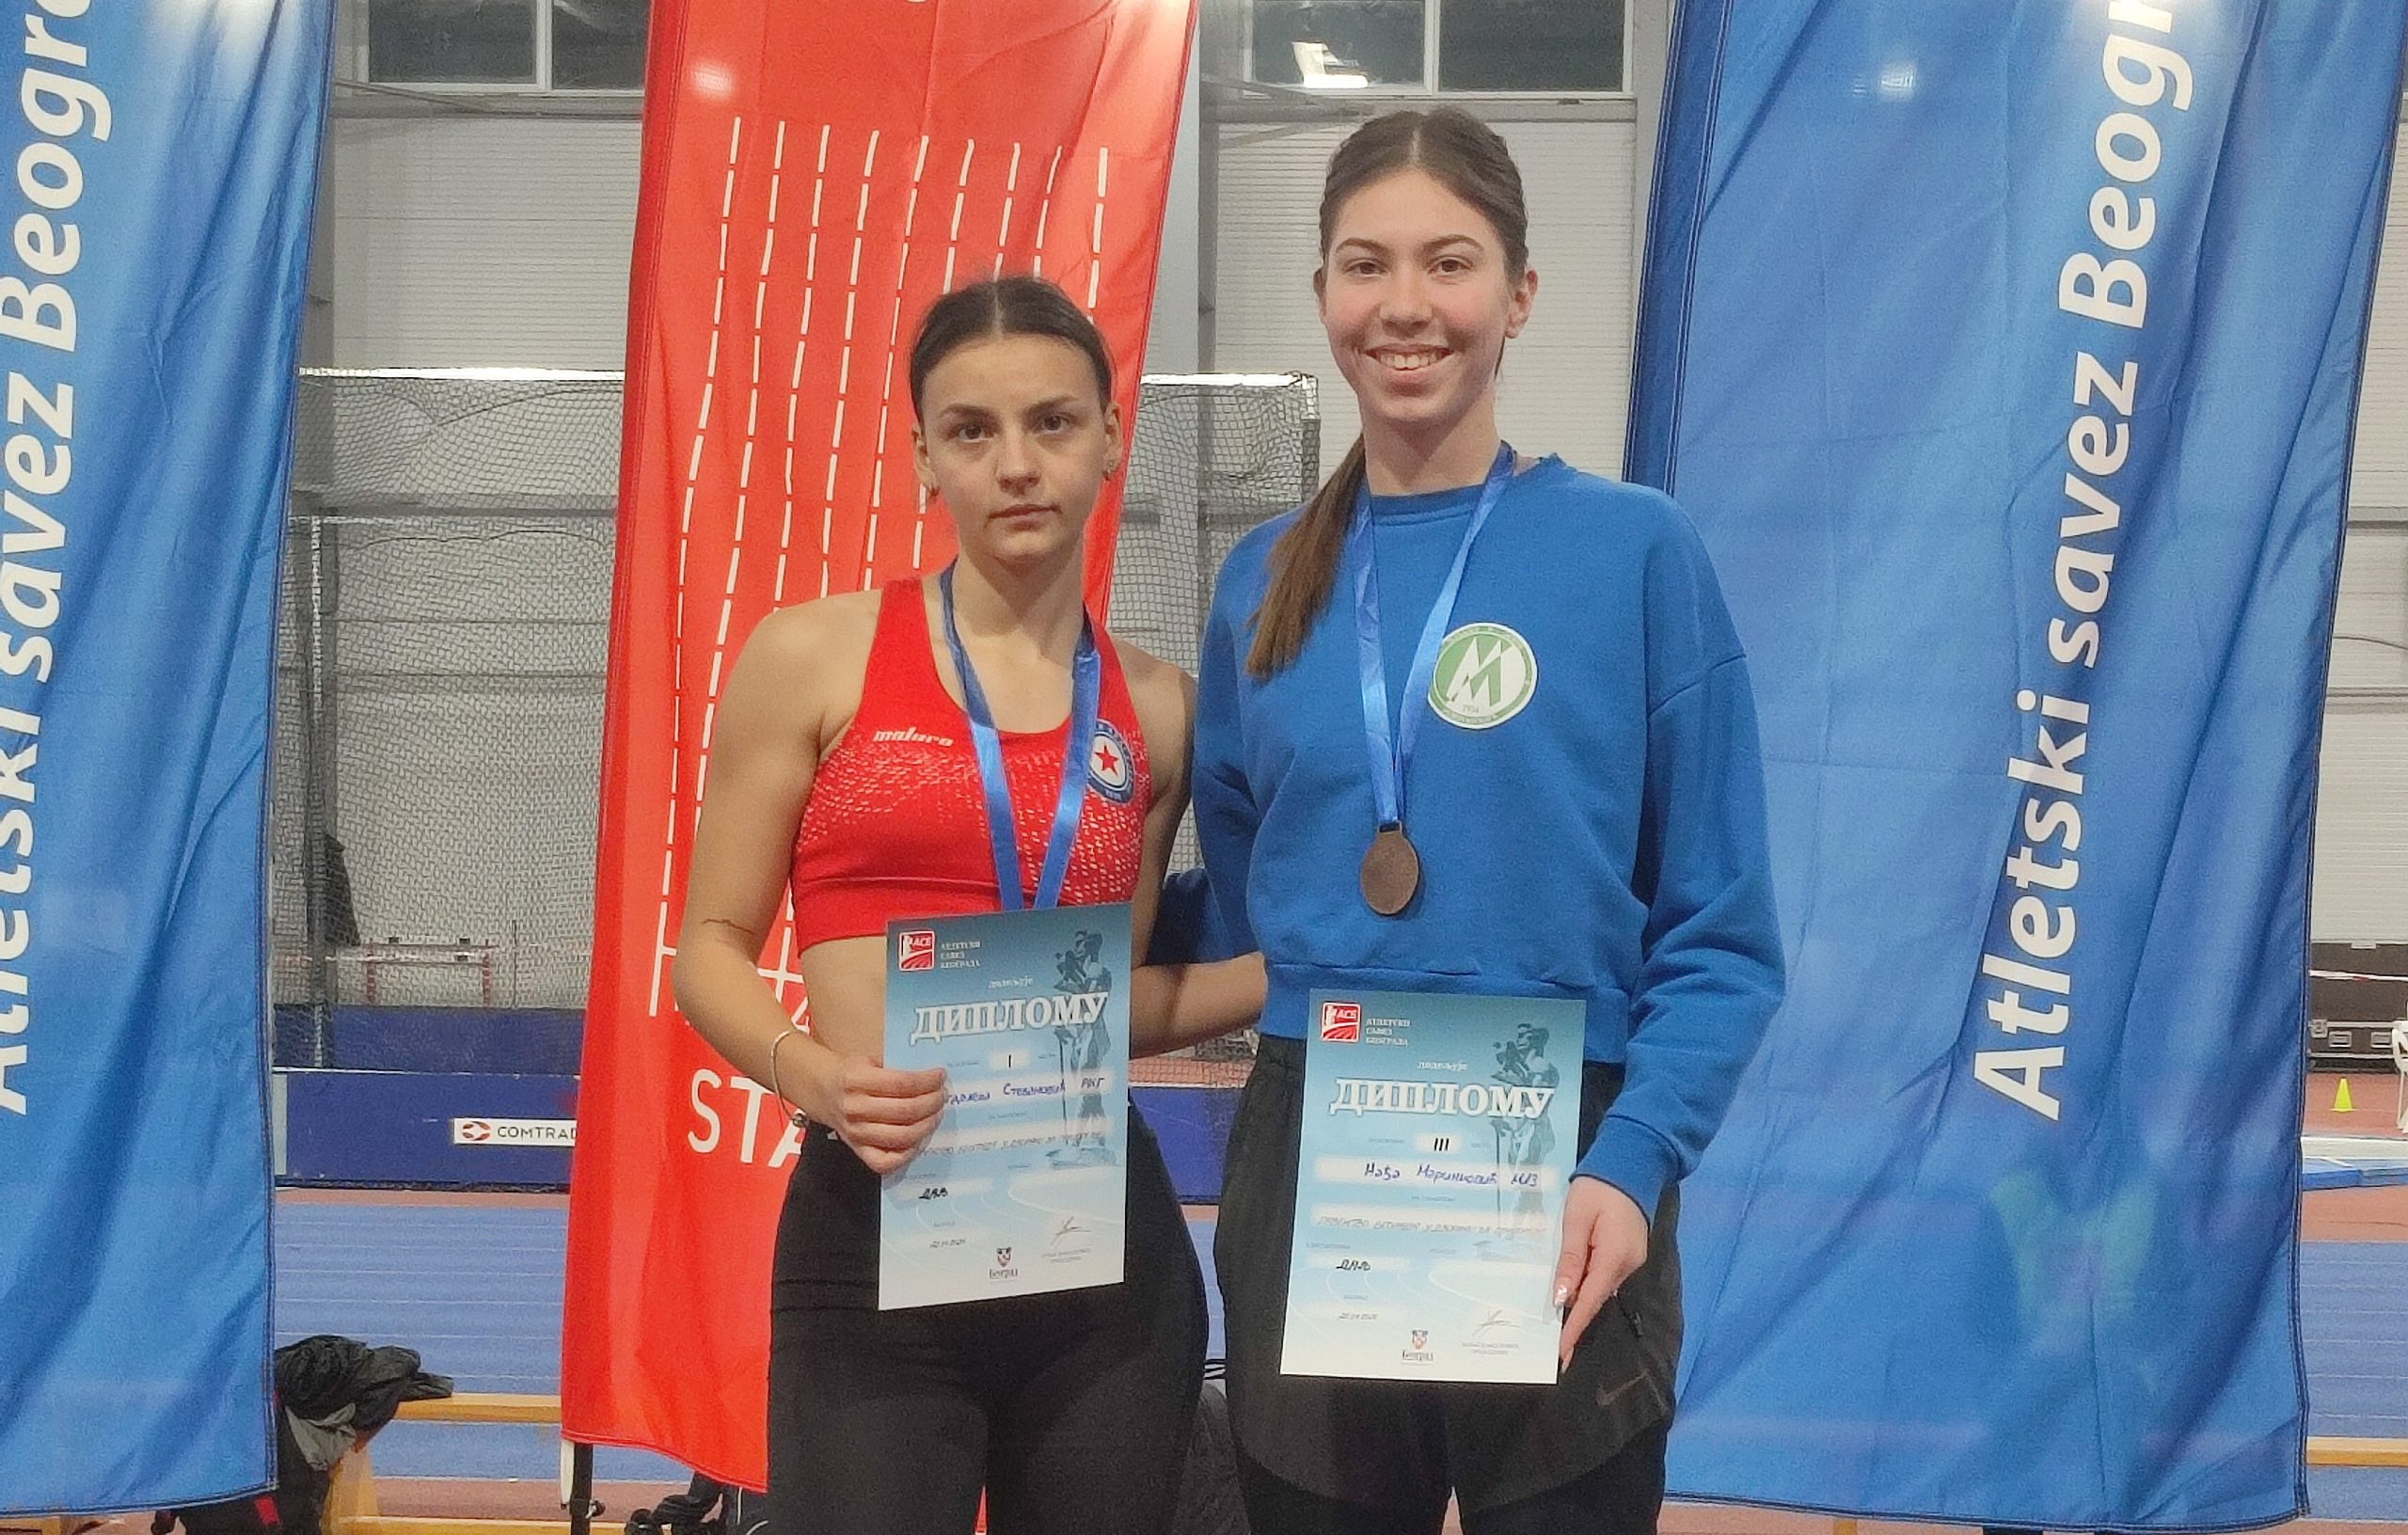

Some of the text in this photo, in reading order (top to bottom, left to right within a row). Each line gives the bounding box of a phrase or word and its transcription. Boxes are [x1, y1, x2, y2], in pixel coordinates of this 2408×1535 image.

[0, 0, 113, 353] Beogr
[1973, 688, 2090, 1122] Atletski
[2047, 351, 2138, 669] savez
[909, 991, 1109, 1046] ДИПЛОМУ
[1329, 1077, 1556, 1119] ДИПЛОМУ
[498, 1126, 578, 1140] COMTRAD
[1434, 1137, 1450, 1152] III
